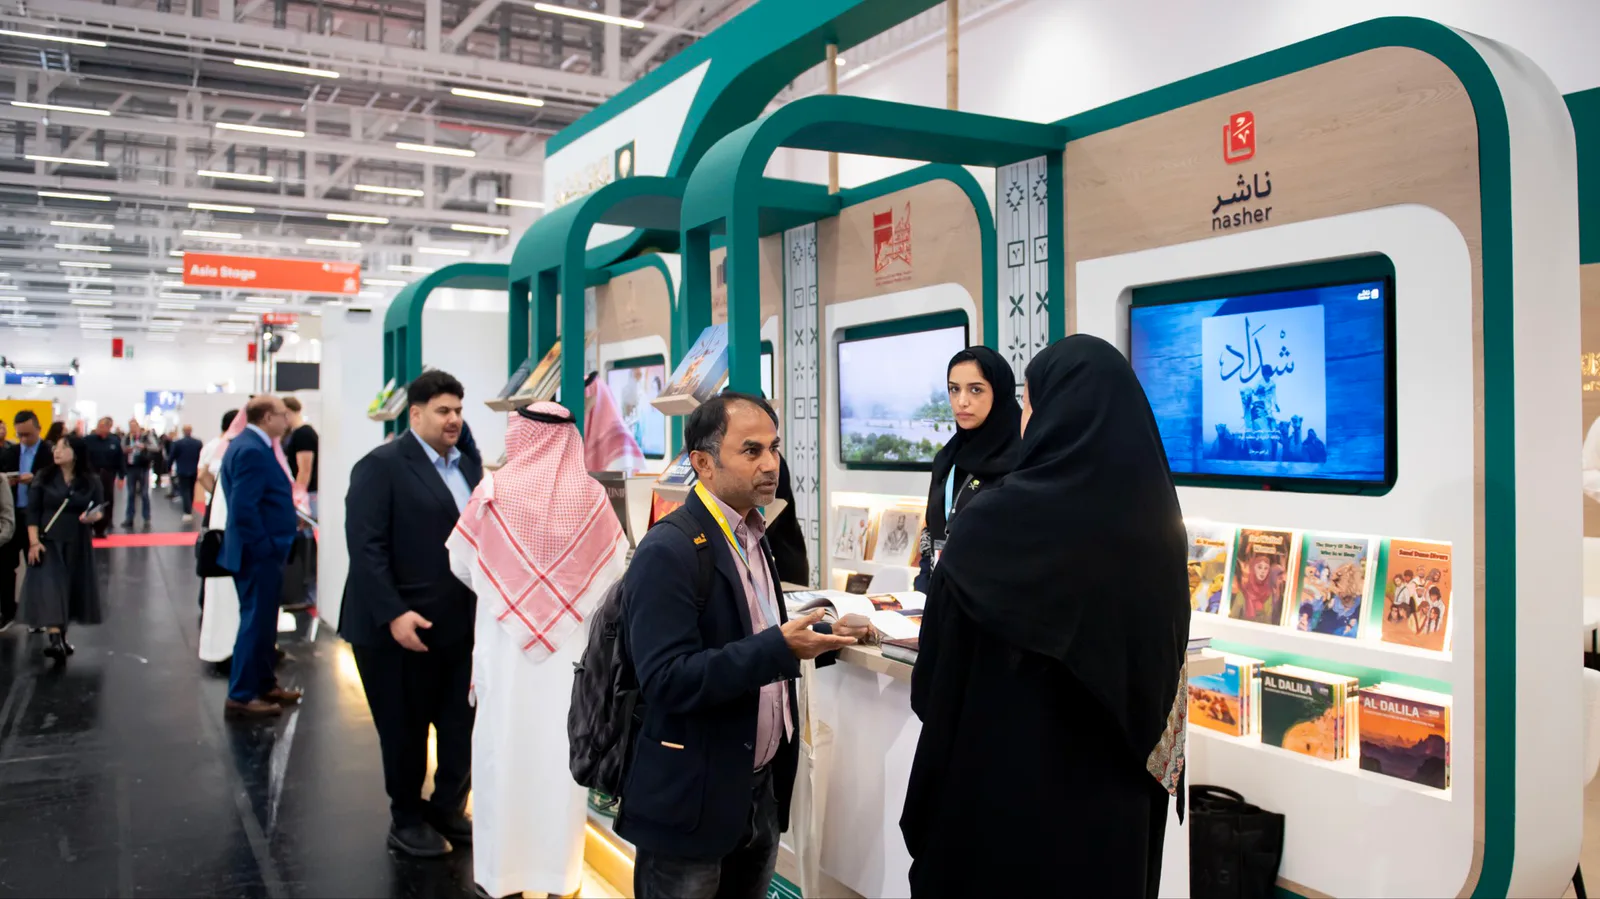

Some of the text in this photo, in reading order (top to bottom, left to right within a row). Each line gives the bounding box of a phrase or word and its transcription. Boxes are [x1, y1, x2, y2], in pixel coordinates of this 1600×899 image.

[1212, 171, 1272, 215] ناشر
[1212, 206, 1272, 231] nasher
[190, 263, 257, 281] Asia Stage
[1399, 549, 1413, 557] Sand
[1430, 552, 1448, 561] Divers
[1264, 676, 1277, 688] AL
[1278, 678, 1313, 696] DALILA
[1364, 697, 1378, 709] AL
[1380, 700, 1420, 718] DALILA
